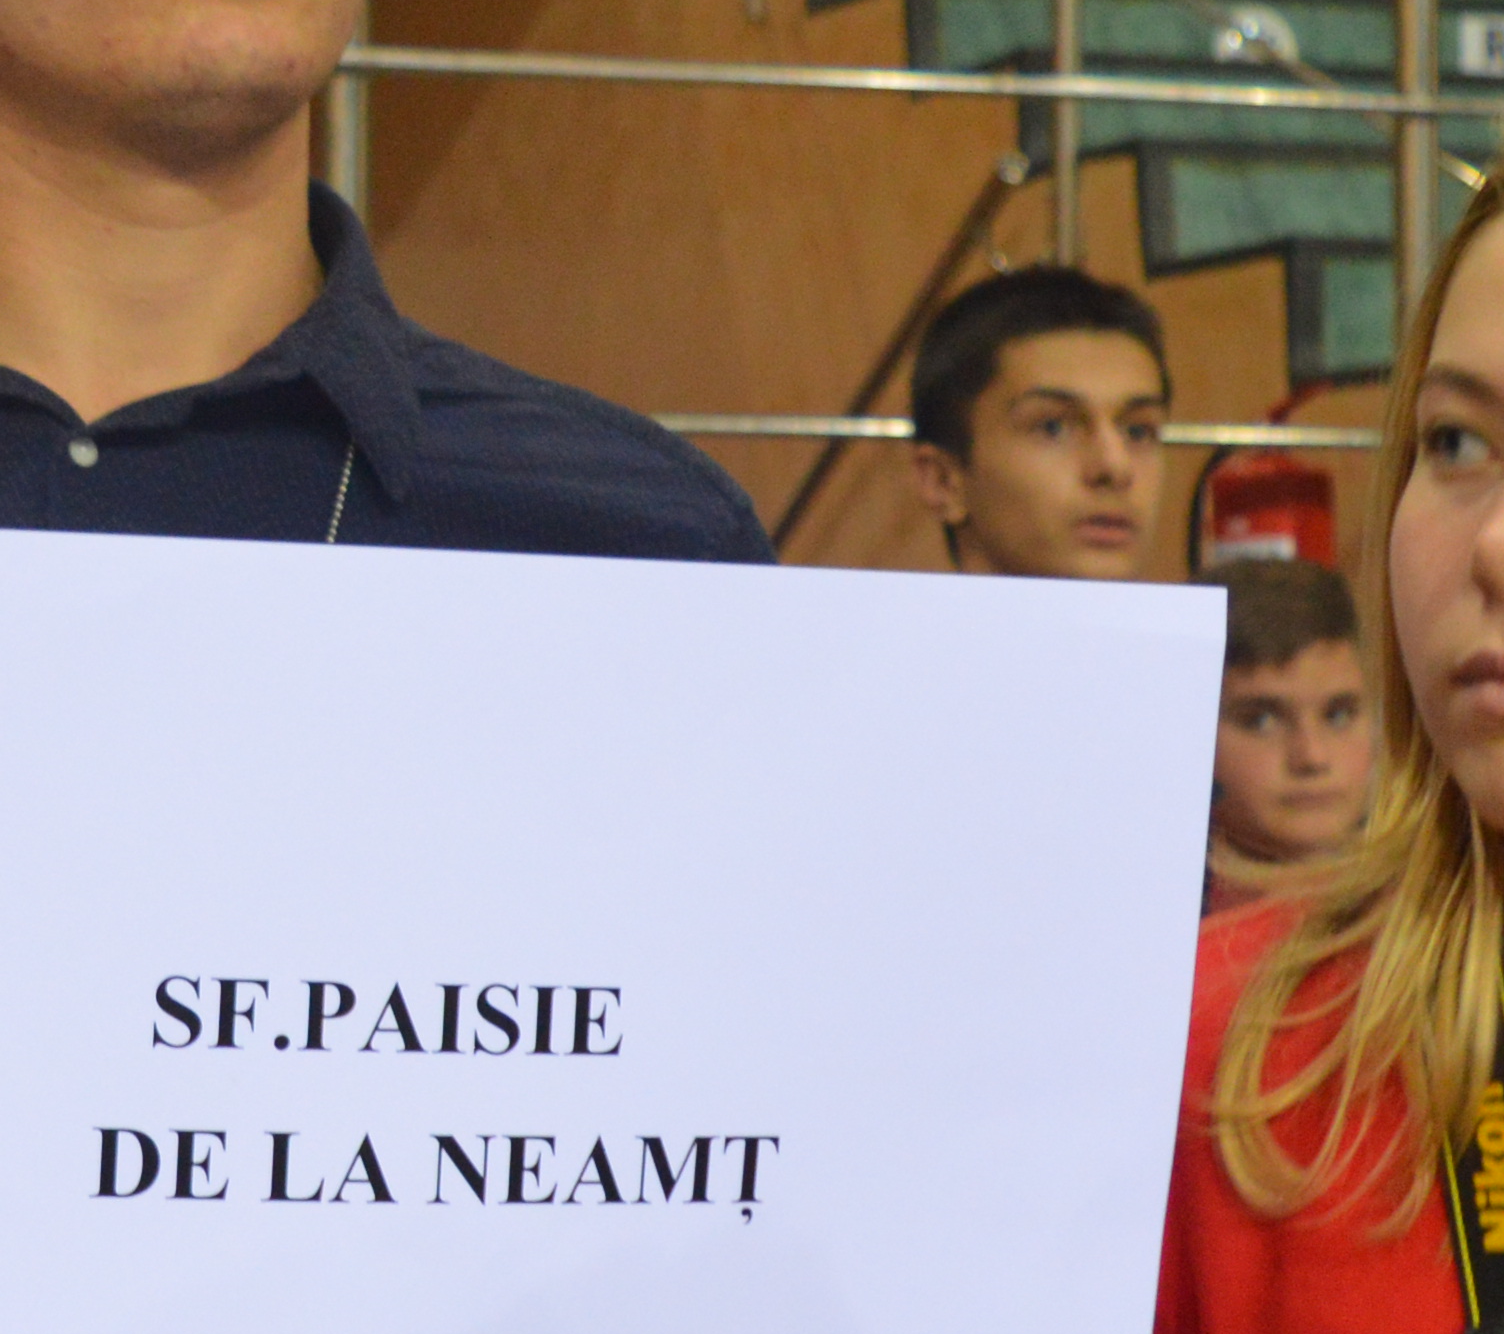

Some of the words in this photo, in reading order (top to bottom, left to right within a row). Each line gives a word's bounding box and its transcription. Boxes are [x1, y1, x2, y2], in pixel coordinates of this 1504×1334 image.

[152, 974, 625, 1057] SF.PAISIE
[90, 1126, 230, 1201] DE
[261, 1131, 398, 1204] LA
[426, 1133, 781, 1225] NEAMȚ
